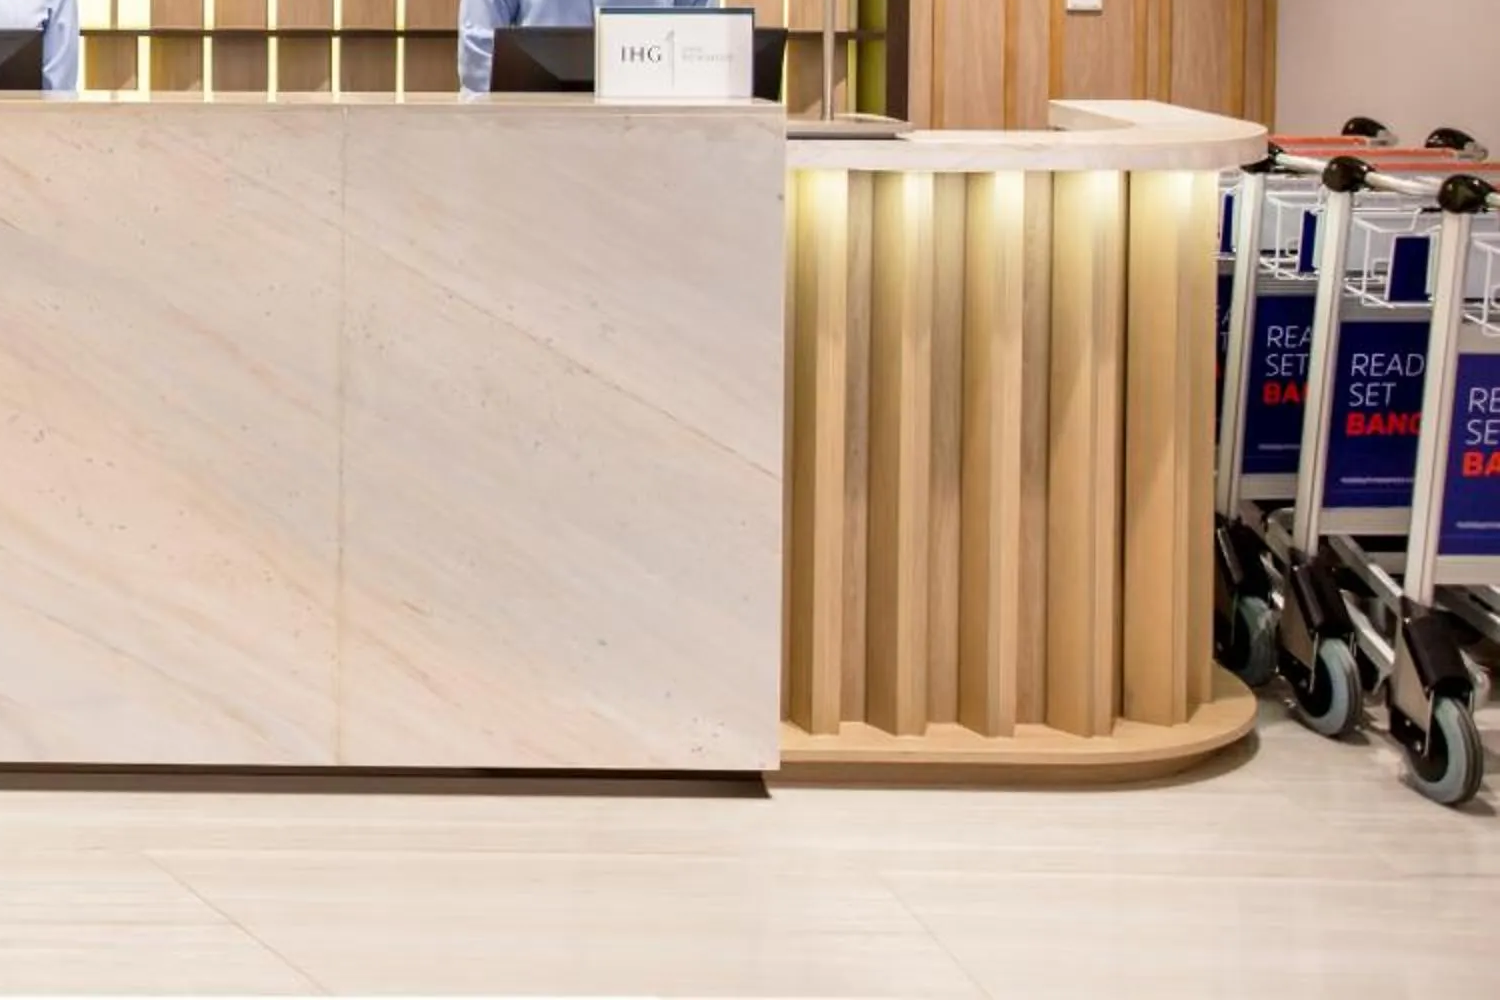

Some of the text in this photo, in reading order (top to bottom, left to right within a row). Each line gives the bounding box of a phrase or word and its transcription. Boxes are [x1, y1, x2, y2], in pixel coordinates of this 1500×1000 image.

[620, 45, 662, 63] IHG
[1266, 324, 1314, 349] REA
[1265, 353, 1309, 378] SET
[1350, 352, 1426, 378] READ
[1349, 381, 1397, 408] SET
[1468, 386, 1500, 414] RE
[1464, 418, 1500, 446] SE
[1462, 451, 1500, 478] BA
